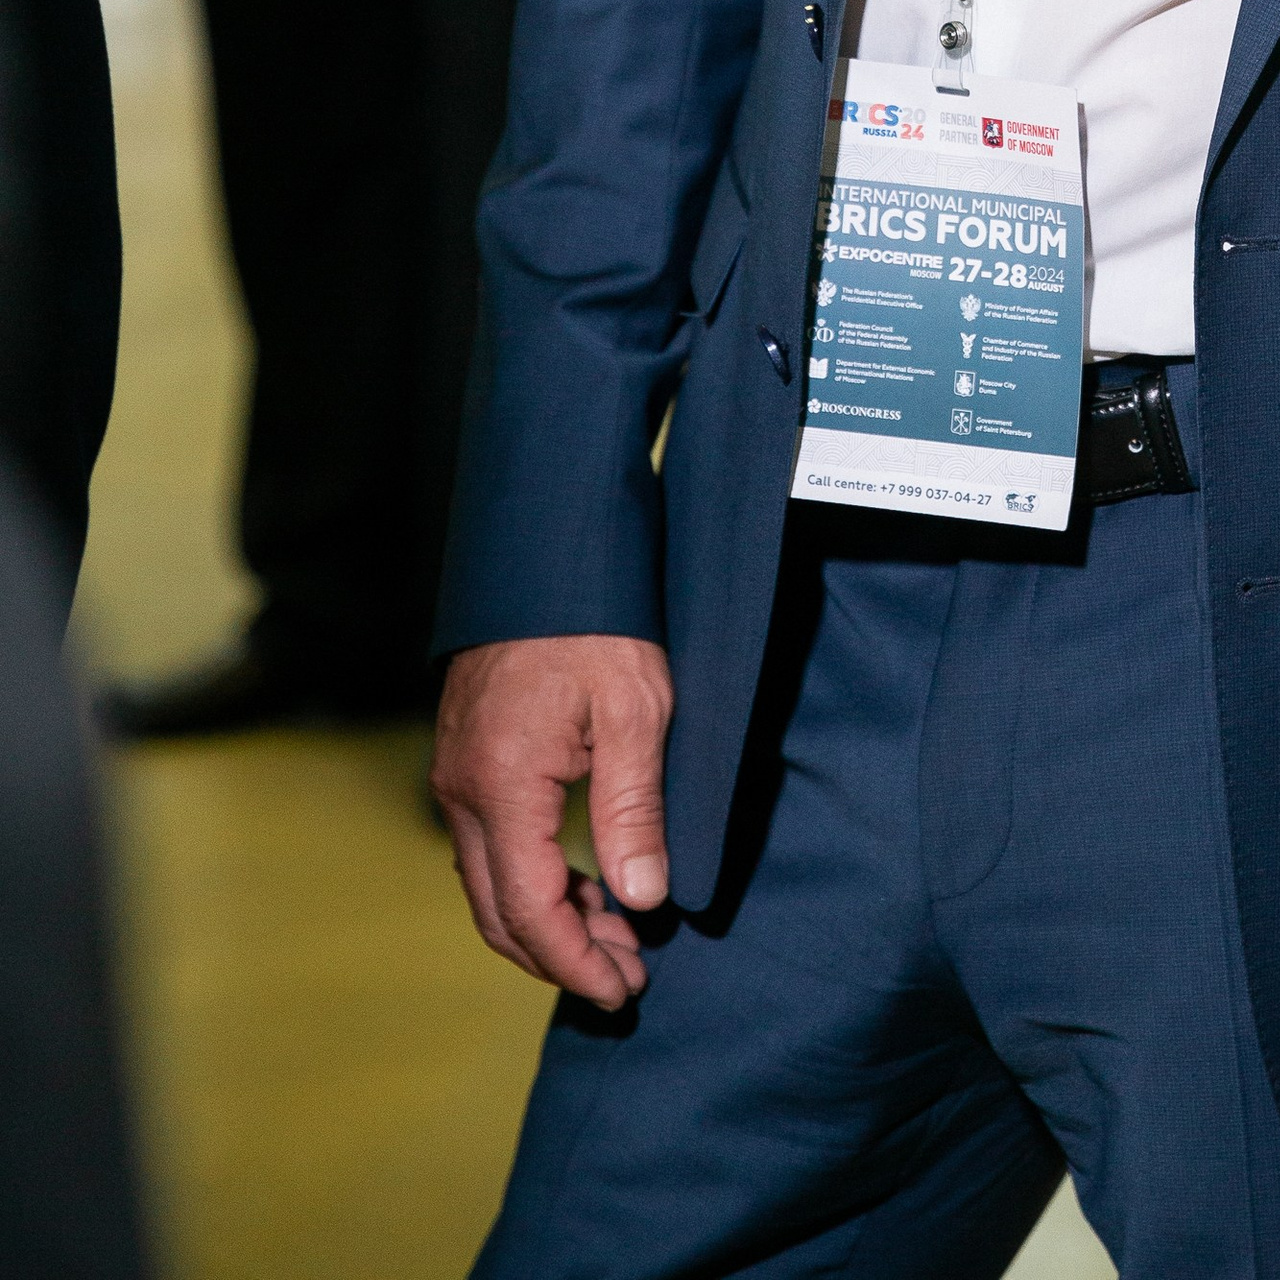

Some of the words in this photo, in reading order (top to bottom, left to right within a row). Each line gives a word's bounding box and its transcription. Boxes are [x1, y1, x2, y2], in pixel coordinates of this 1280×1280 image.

[940, 112, 978, 128] GENERAL
[862, 127, 897, 138] RUSSIA
[901, 123, 925, 140] 24
[940, 130, 978, 145] PARTNER
[1007, 121, 1060, 141] GOVERNMENT
[1007, 138, 1017, 151] OF
[1019, 140, 1054, 157] MOSCOW
[820, 183, 968, 213] INTERNATIONAL
[972, 199, 1067, 226] MUNICIPAL
[817, 202, 927, 241] BRICS
[937, 214, 1067, 258] FORUM
[839, 245, 943, 269] EXPOCENTRE
[910, 269, 942, 280] MOSCOW
[948, 256, 1027, 288] 27-28
[1028, 265, 1065, 283] 2024
[1027, 281, 1065, 293] AUGUST
[821, 402, 902, 421] ROSCONGRESS
[807, 474, 831, 487] Call
[834, 479, 877, 492] centre:
[880, 483, 895, 494] +7
[898, 484, 922, 498] 999
[925, 488, 992, 506] 037-04-27
